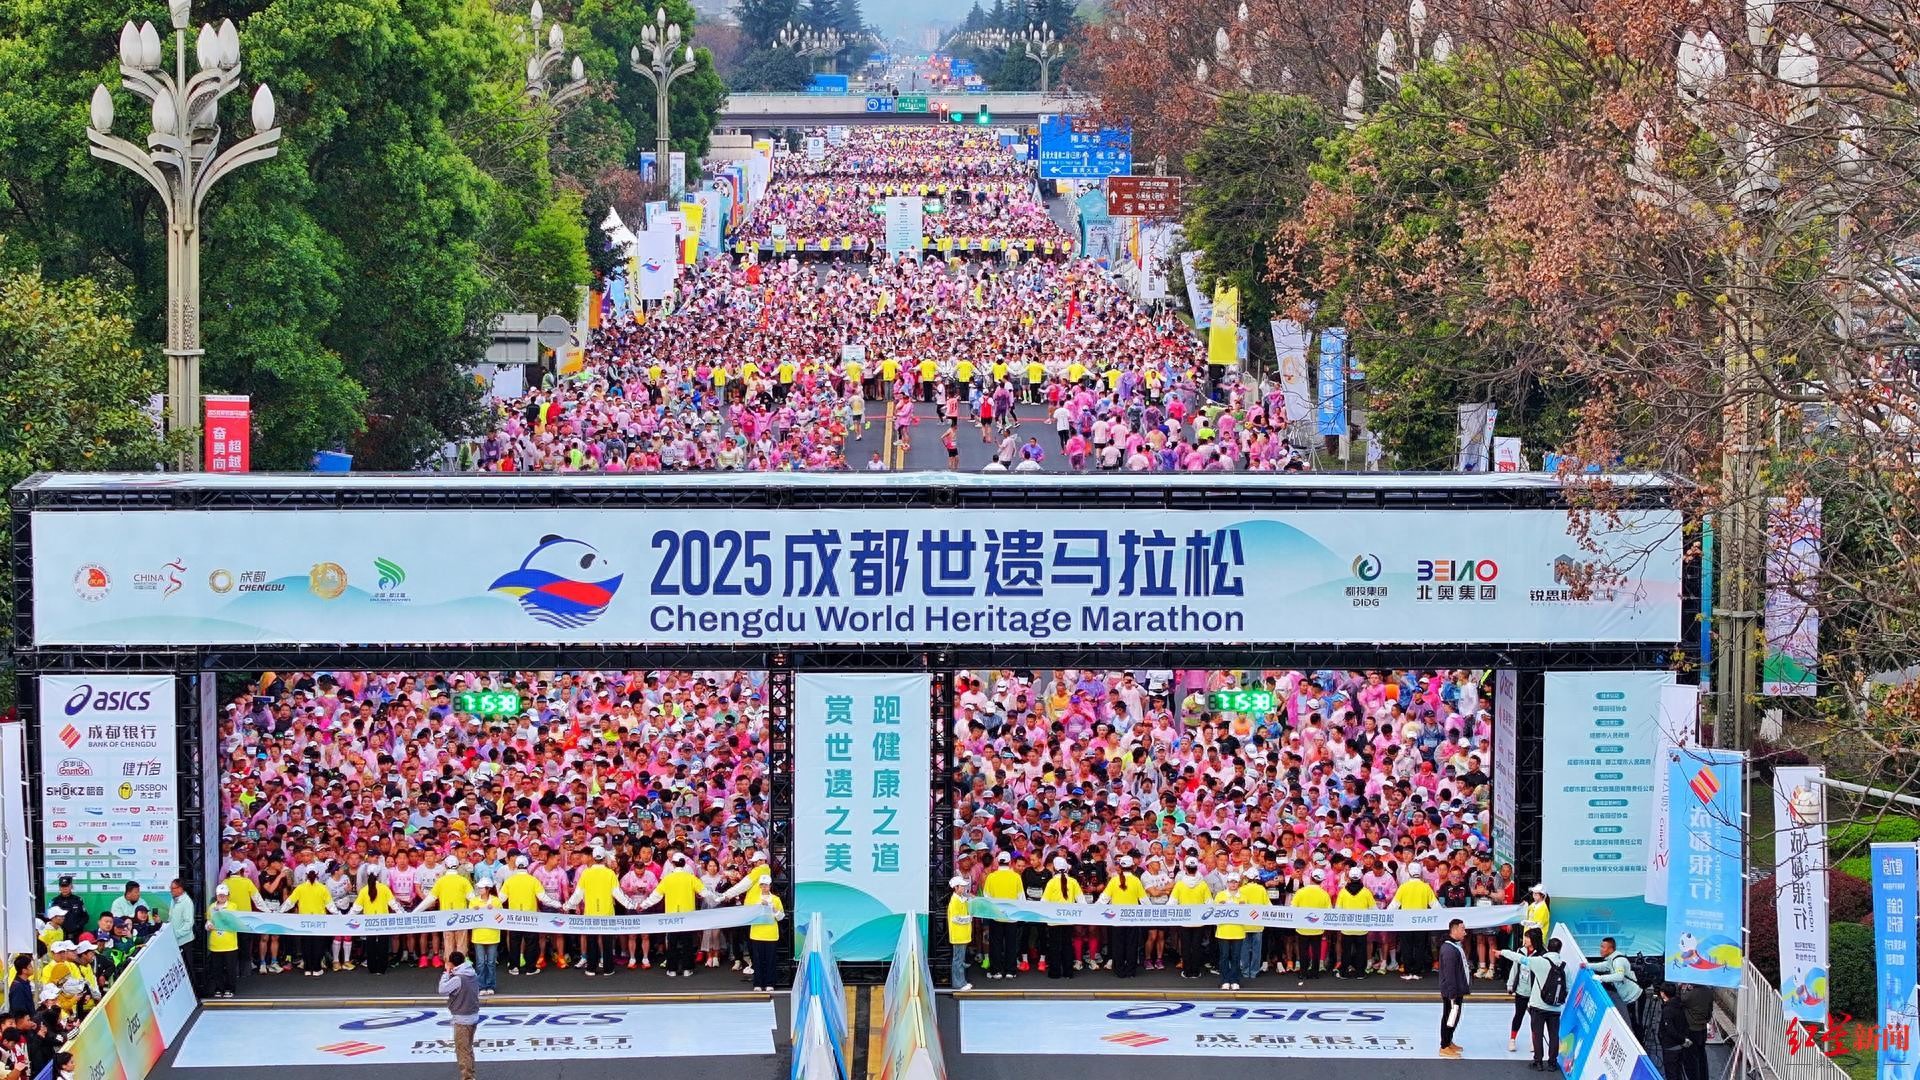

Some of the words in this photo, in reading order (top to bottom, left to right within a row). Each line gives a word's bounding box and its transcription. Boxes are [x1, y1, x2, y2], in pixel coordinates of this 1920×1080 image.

[228, 440, 241, 473] 超越
[650, 528, 1244, 597] 2025成都世遗马拉松
[133, 574, 164, 582] CHINA
[239, 571, 266, 583] 成都
[1345, 587, 1388, 597] 都投集团
[1416, 585, 1496, 600] 北奥集团
[1353, 598, 1379, 607] DIDG
[650, 605, 806, 638] Chengdu
[815, 605, 914, 631] World
[925, 605, 1072, 638] Heritage
[1081, 605, 1244, 631] Marathon
[88, 725, 157, 739] 成都银行
[122, 761, 162, 776] 健力多
[133, 784, 168, 792] JISSBON
[824, 695, 853, 872] 赏世遗之美
[872, 695, 900, 872] 跑健康之道
[46, 786, 85, 796] SHOKZ
[1056, 909, 1083, 917] START
[300, 920, 328, 929] START
[658, 917, 685, 926] START
[1411, 915, 1438, 924] START
[1200, 1007, 1386, 1023] asics
[1196, 1032, 1415, 1045] 成都银行
[516, 1045, 633, 1053] CHENGDU
[1196, 1043, 1248, 1051] BANK
[1258, 1043, 1289, 1051] OF
[1299, 1043, 1415, 1051] CHENGDU
